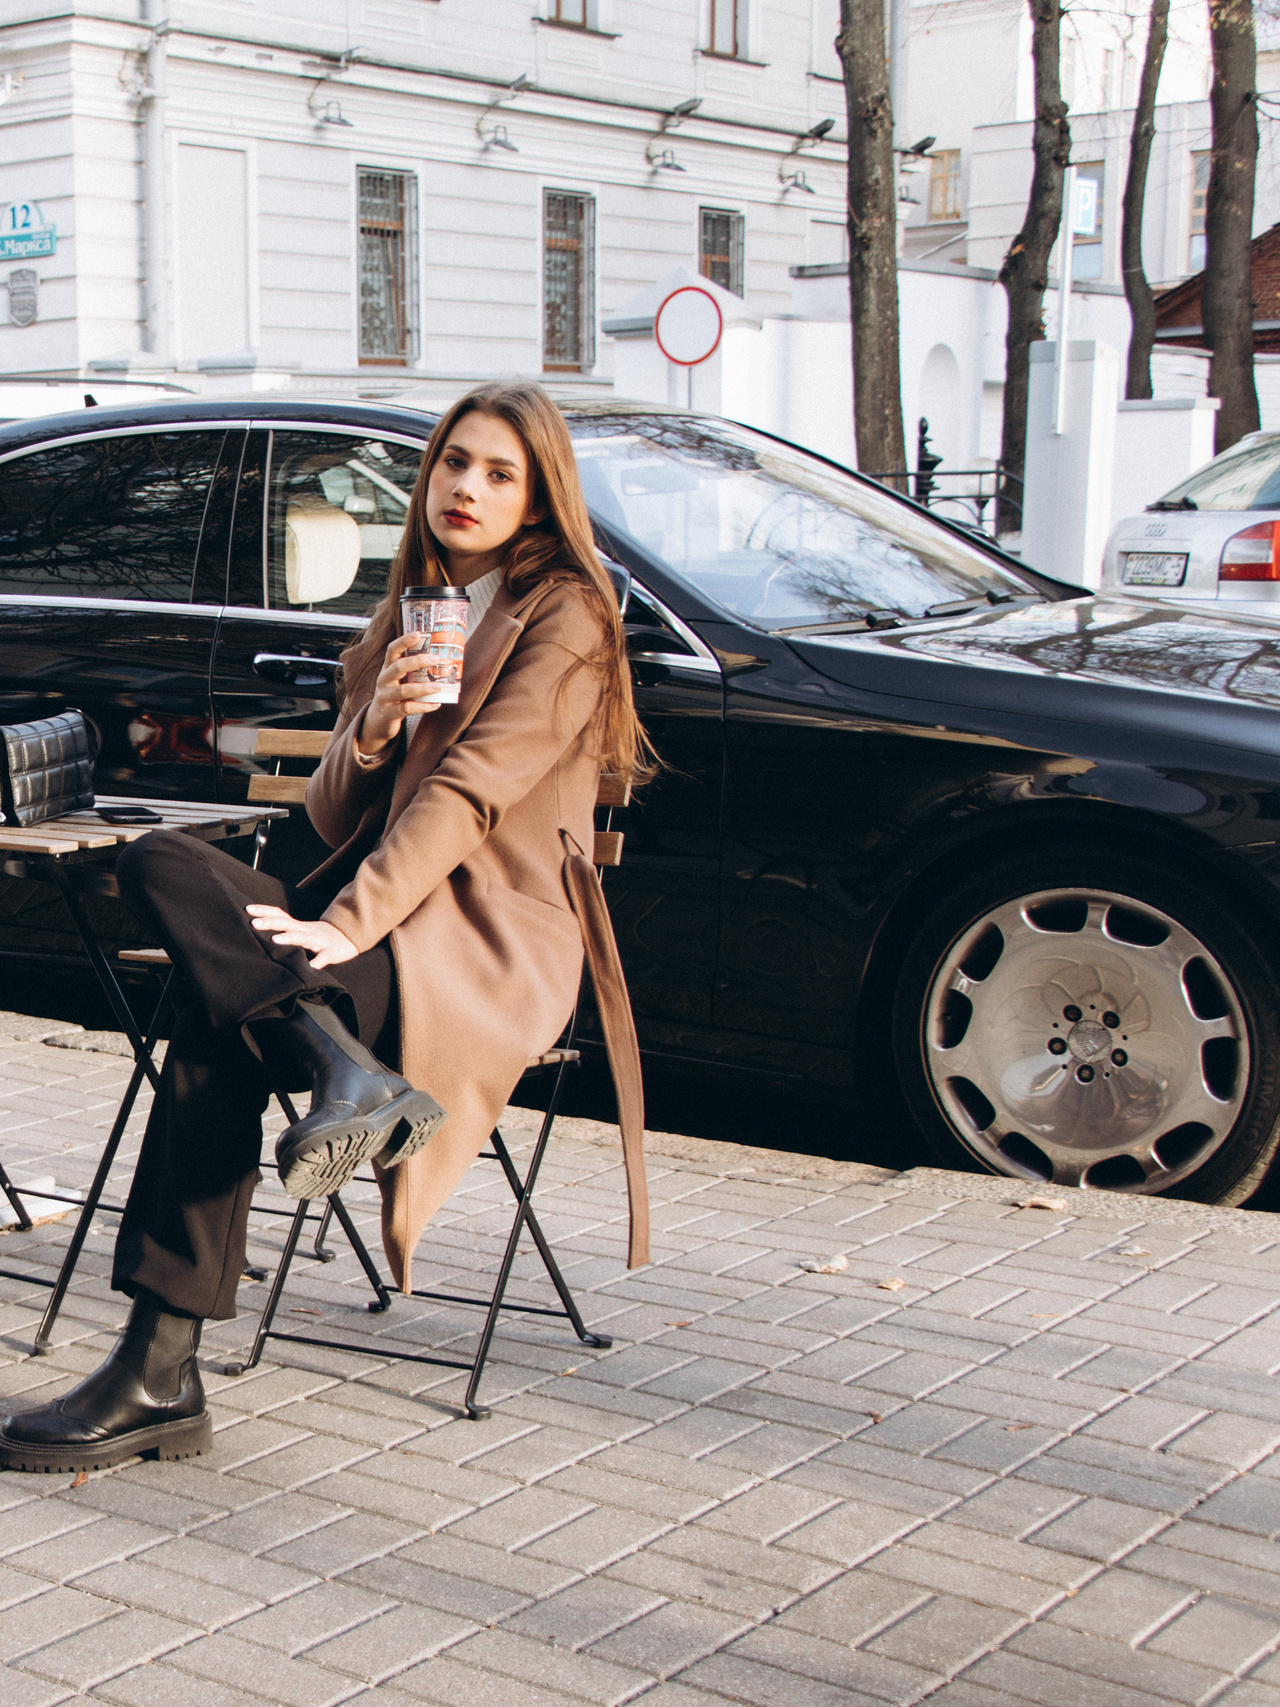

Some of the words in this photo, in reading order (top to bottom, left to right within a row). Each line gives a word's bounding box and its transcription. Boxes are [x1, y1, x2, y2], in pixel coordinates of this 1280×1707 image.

[10, 204, 31, 230] 12
[1077, 187, 1092, 225] P
[1243, 1048, 1280, 1145] KUMHO
